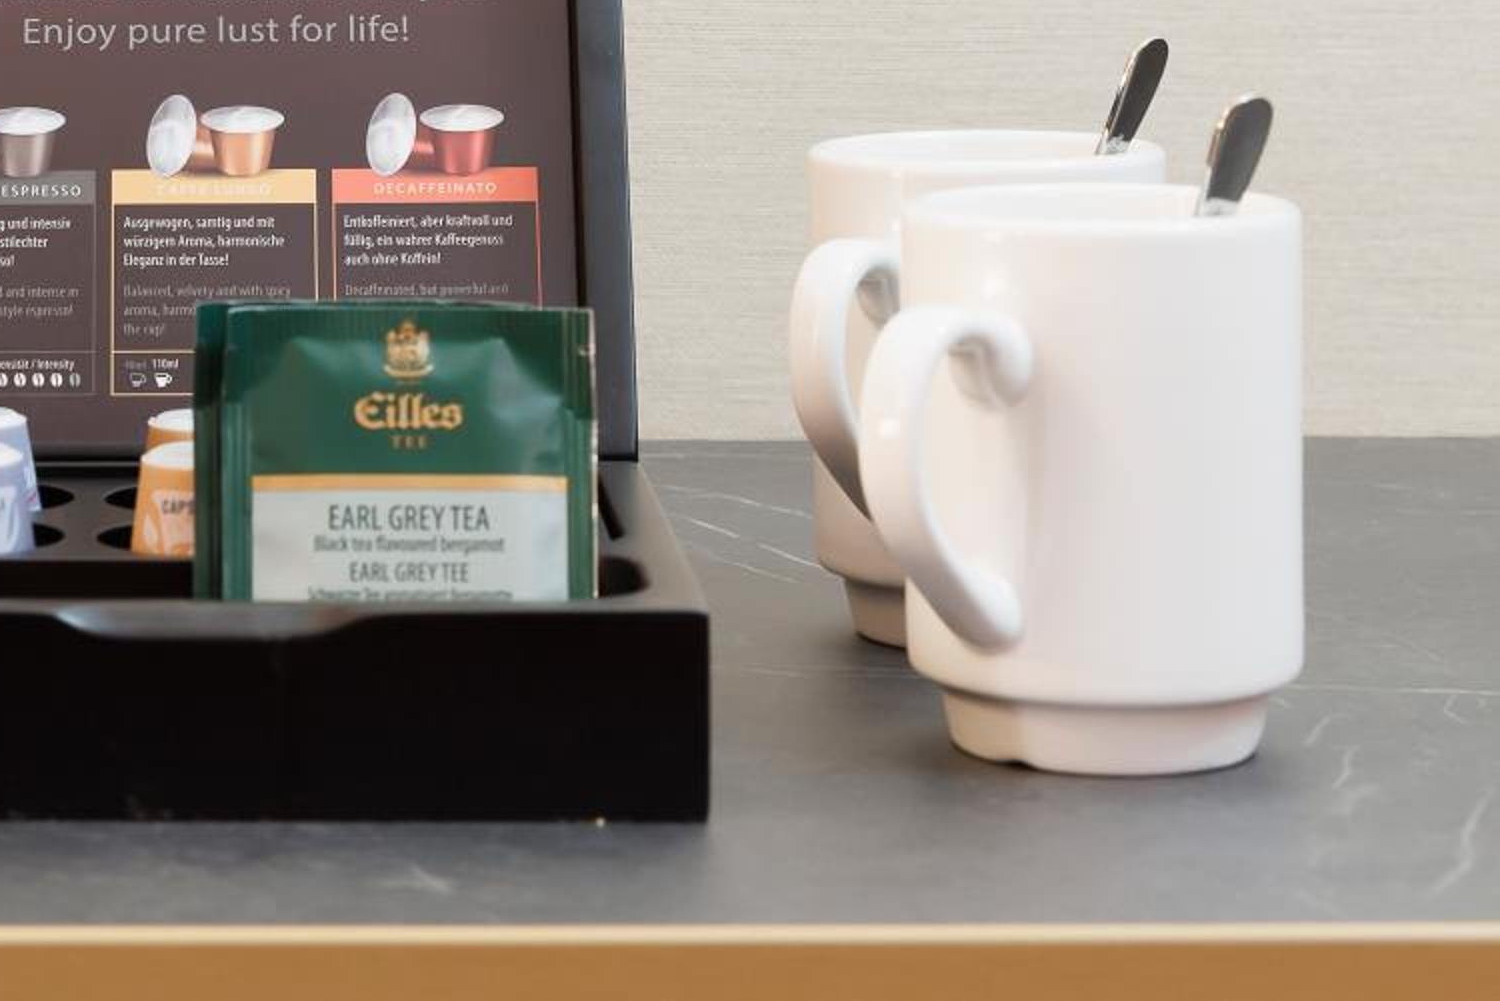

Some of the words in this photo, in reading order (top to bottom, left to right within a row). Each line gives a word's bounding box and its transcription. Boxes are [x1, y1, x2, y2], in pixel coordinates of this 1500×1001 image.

[23, 17, 117, 52] Enjoy
[128, 22, 207, 51] pure
[218, 14, 279, 43] lust
[289, 13, 338, 43] for
[348, 13, 410, 43] life!
[0, 184, 82, 198] ESPRESSO
[373, 182, 498, 196] DECAFFEINATO
[7, 216, 29, 230] und
[30, 216, 72, 230] intensiv
[123, 216, 194, 232] Ausgewogen,
[195, 216, 231, 232] samtig
[233, 216, 255, 229] und
[256, 216, 276, 229] mit
[419, 214, 444, 228] aber
[445, 214, 490, 228] kraftvoll
[491, 214, 513, 227] und
[0, 235, 50, 248] stilechter
[123, 235, 176, 250] würzigem
[177, 235, 215, 249] Aroma,
[217, 235, 286, 248] harmonische
[377, 233, 394, 246] ein
[395, 233, 432, 247] wahrer
[123, 253, 165, 269] Eleganz
[166, 253, 177, 266] in
[178, 253, 197, 266] der
[197, 253, 230, 267] Tasse!
[344, 252, 370, 266] auch
[371, 252, 399, 266] ohne
[400, 252, 442, 265] Koffein!
[353, 390, 463, 430] Eilles
[328, 504, 383, 530] EARL
[387, 504, 445, 530] GREY
[449, 504, 490, 530] TEA
[313, 535, 348, 552] Black
[349, 561, 389, 582] EARL
[393, 561, 437, 582] GREY
[441, 561, 469, 582] TEE
